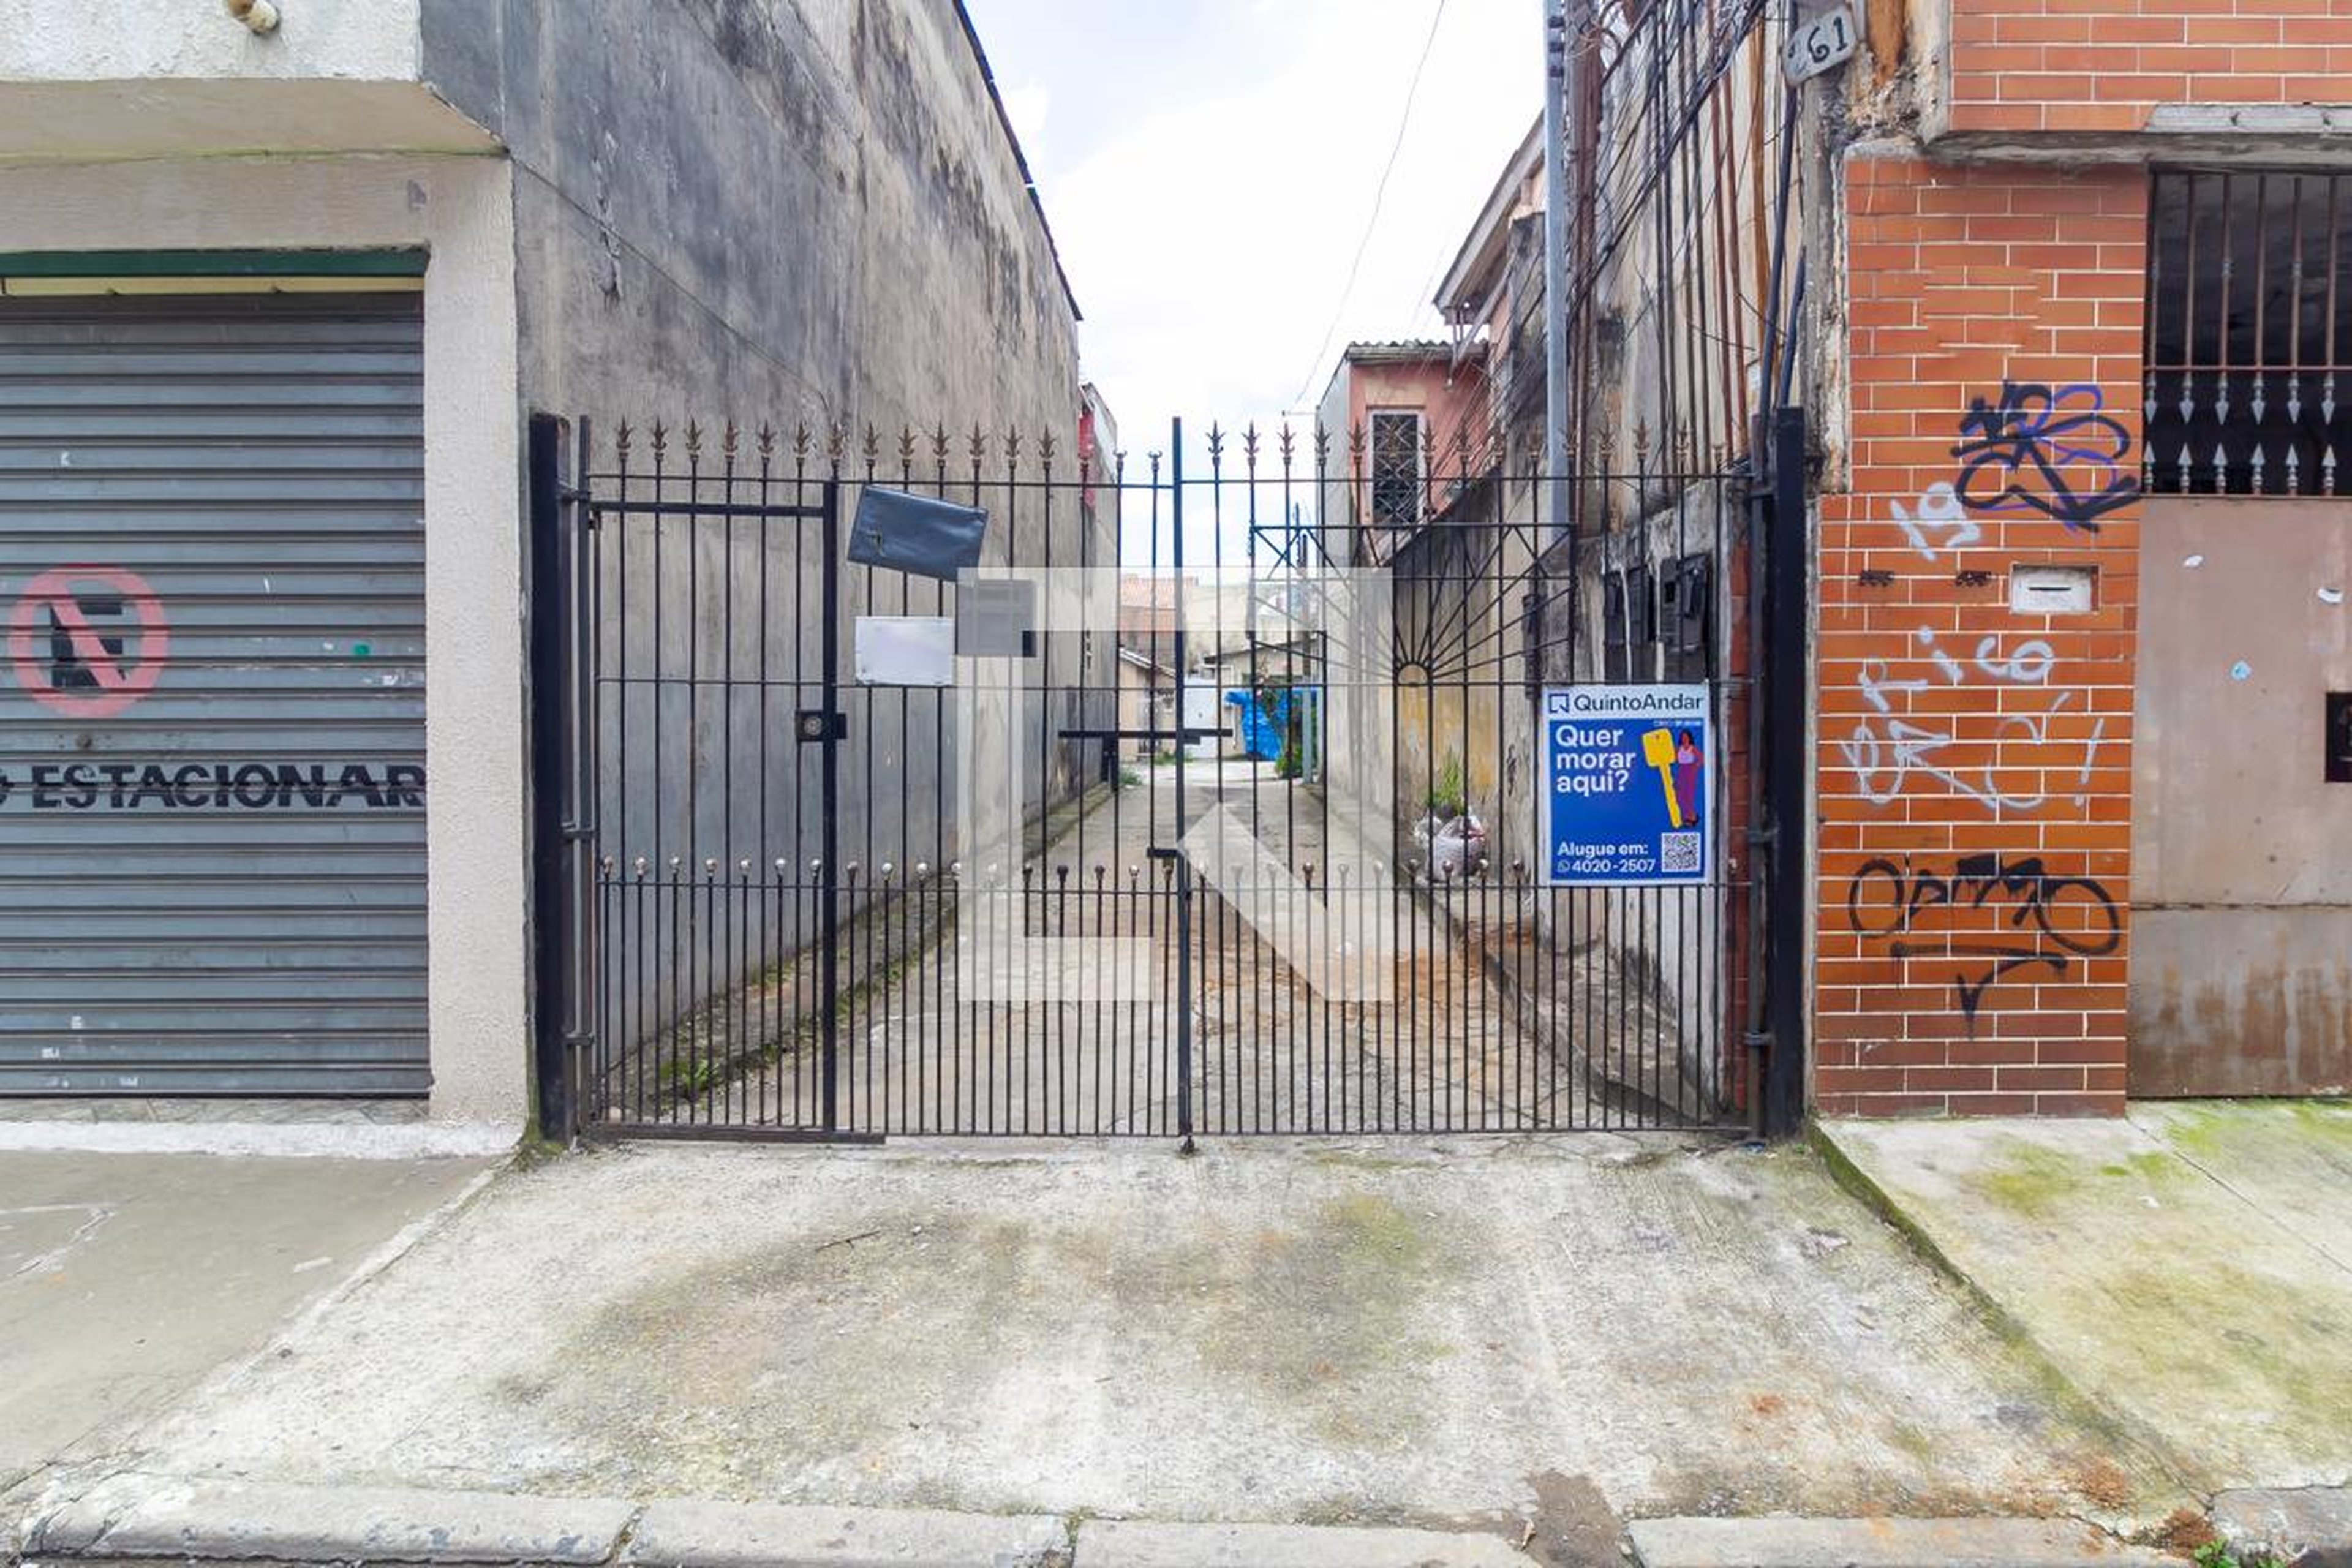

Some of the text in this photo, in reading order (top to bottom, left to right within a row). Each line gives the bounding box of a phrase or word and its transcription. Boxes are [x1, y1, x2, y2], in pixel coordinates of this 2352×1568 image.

[1788, 16, 1848, 74] 61
[1574, 693, 1704, 712] QuintoAndar
[1555, 725, 1623, 748] Quer
[1556, 752, 1636, 769] morar
[31, 764, 427, 809] ESTACIONAR
[1556, 770, 1629, 797] aqui?
[1557, 842, 1649, 859] Alugue em:
[1571, 859, 1656, 873] 4020-2507
